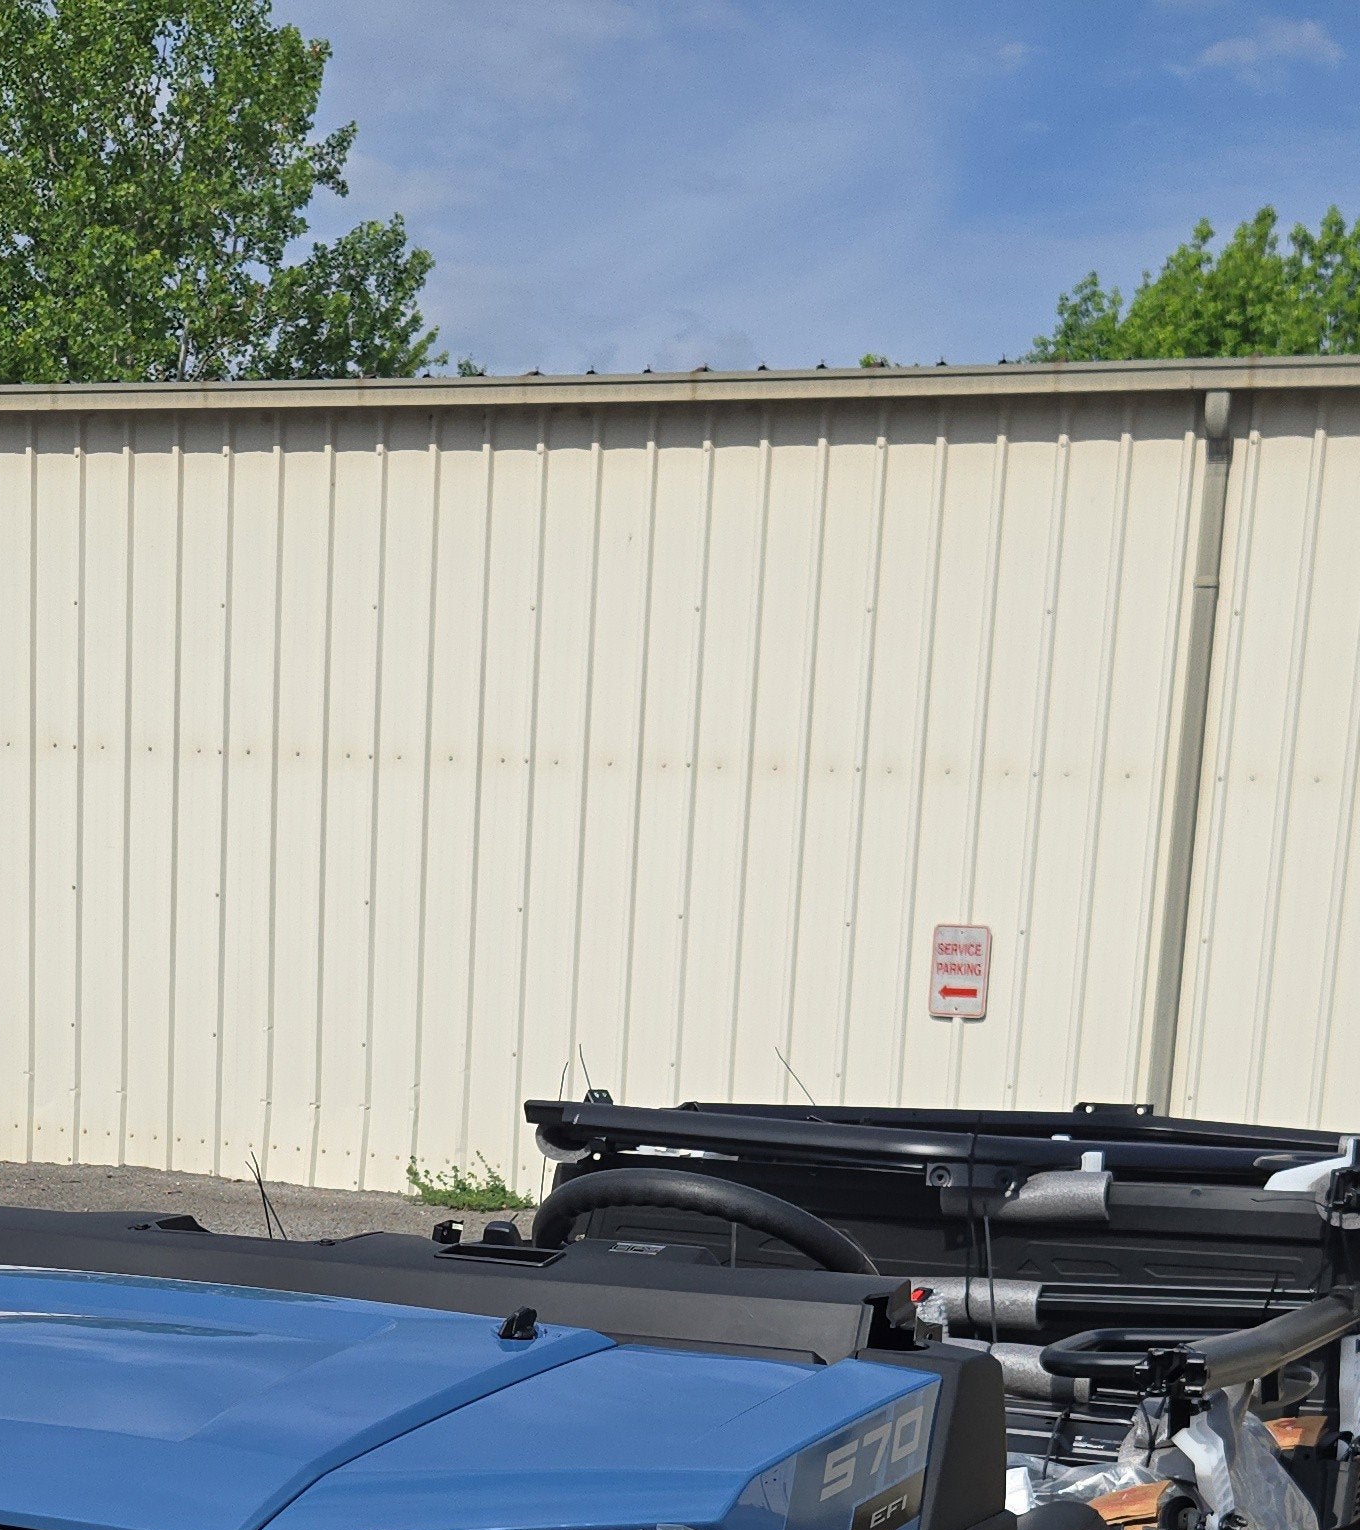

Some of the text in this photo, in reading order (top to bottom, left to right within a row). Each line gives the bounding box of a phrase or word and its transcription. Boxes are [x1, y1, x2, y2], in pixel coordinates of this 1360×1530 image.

[937, 942, 982, 957] SERVICE
[936, 962, 982, 977] PARKING
[820, 1405, 924, 1502] 570
[870, 1494, 908, 1529] EFI
